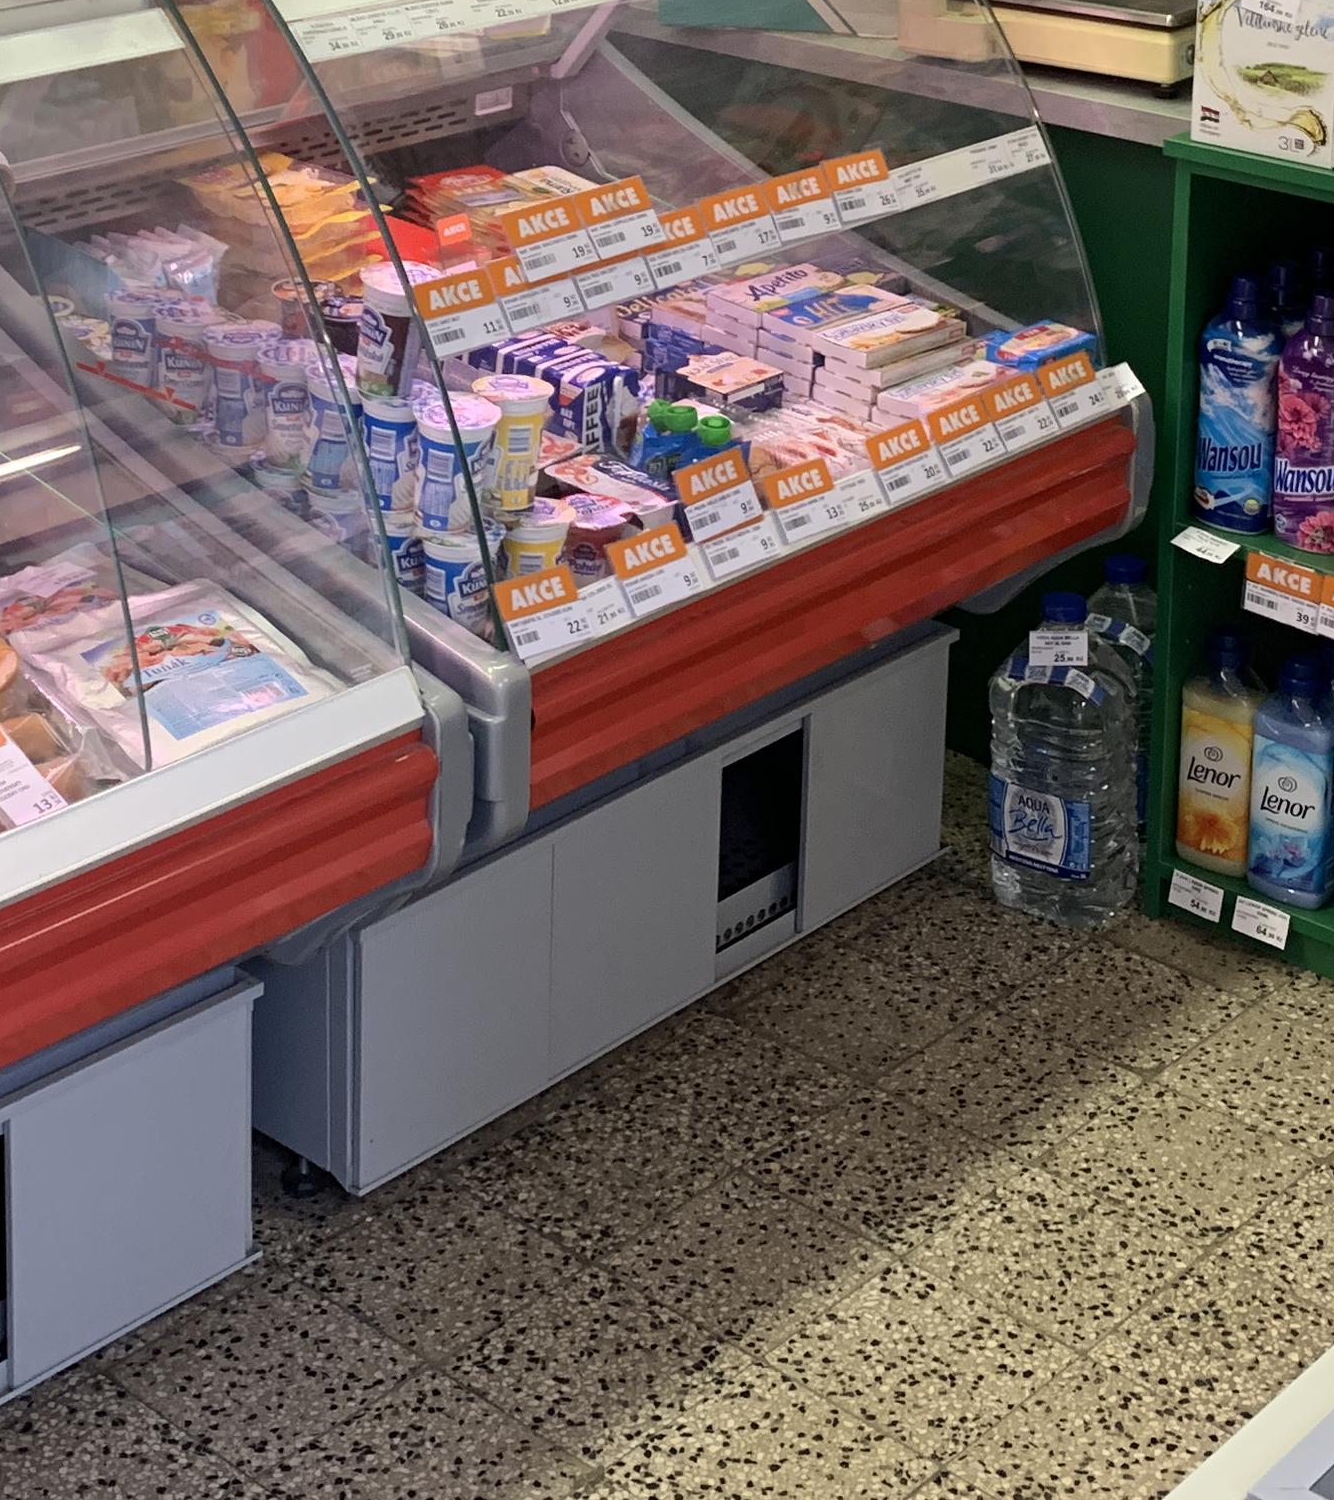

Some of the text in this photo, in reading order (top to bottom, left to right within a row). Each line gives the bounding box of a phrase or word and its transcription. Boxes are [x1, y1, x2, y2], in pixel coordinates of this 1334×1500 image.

[746, 266, 809, 302] Apetito
[1199, 438, 1263, 472] Wansou
[1257, 563, 1312, 595] AKCE
[1186, 758, 1242, 789] Lenor
[1016, 794, 1050, 811] AQUA
[1260, 791, 1316, 822] Lenor
